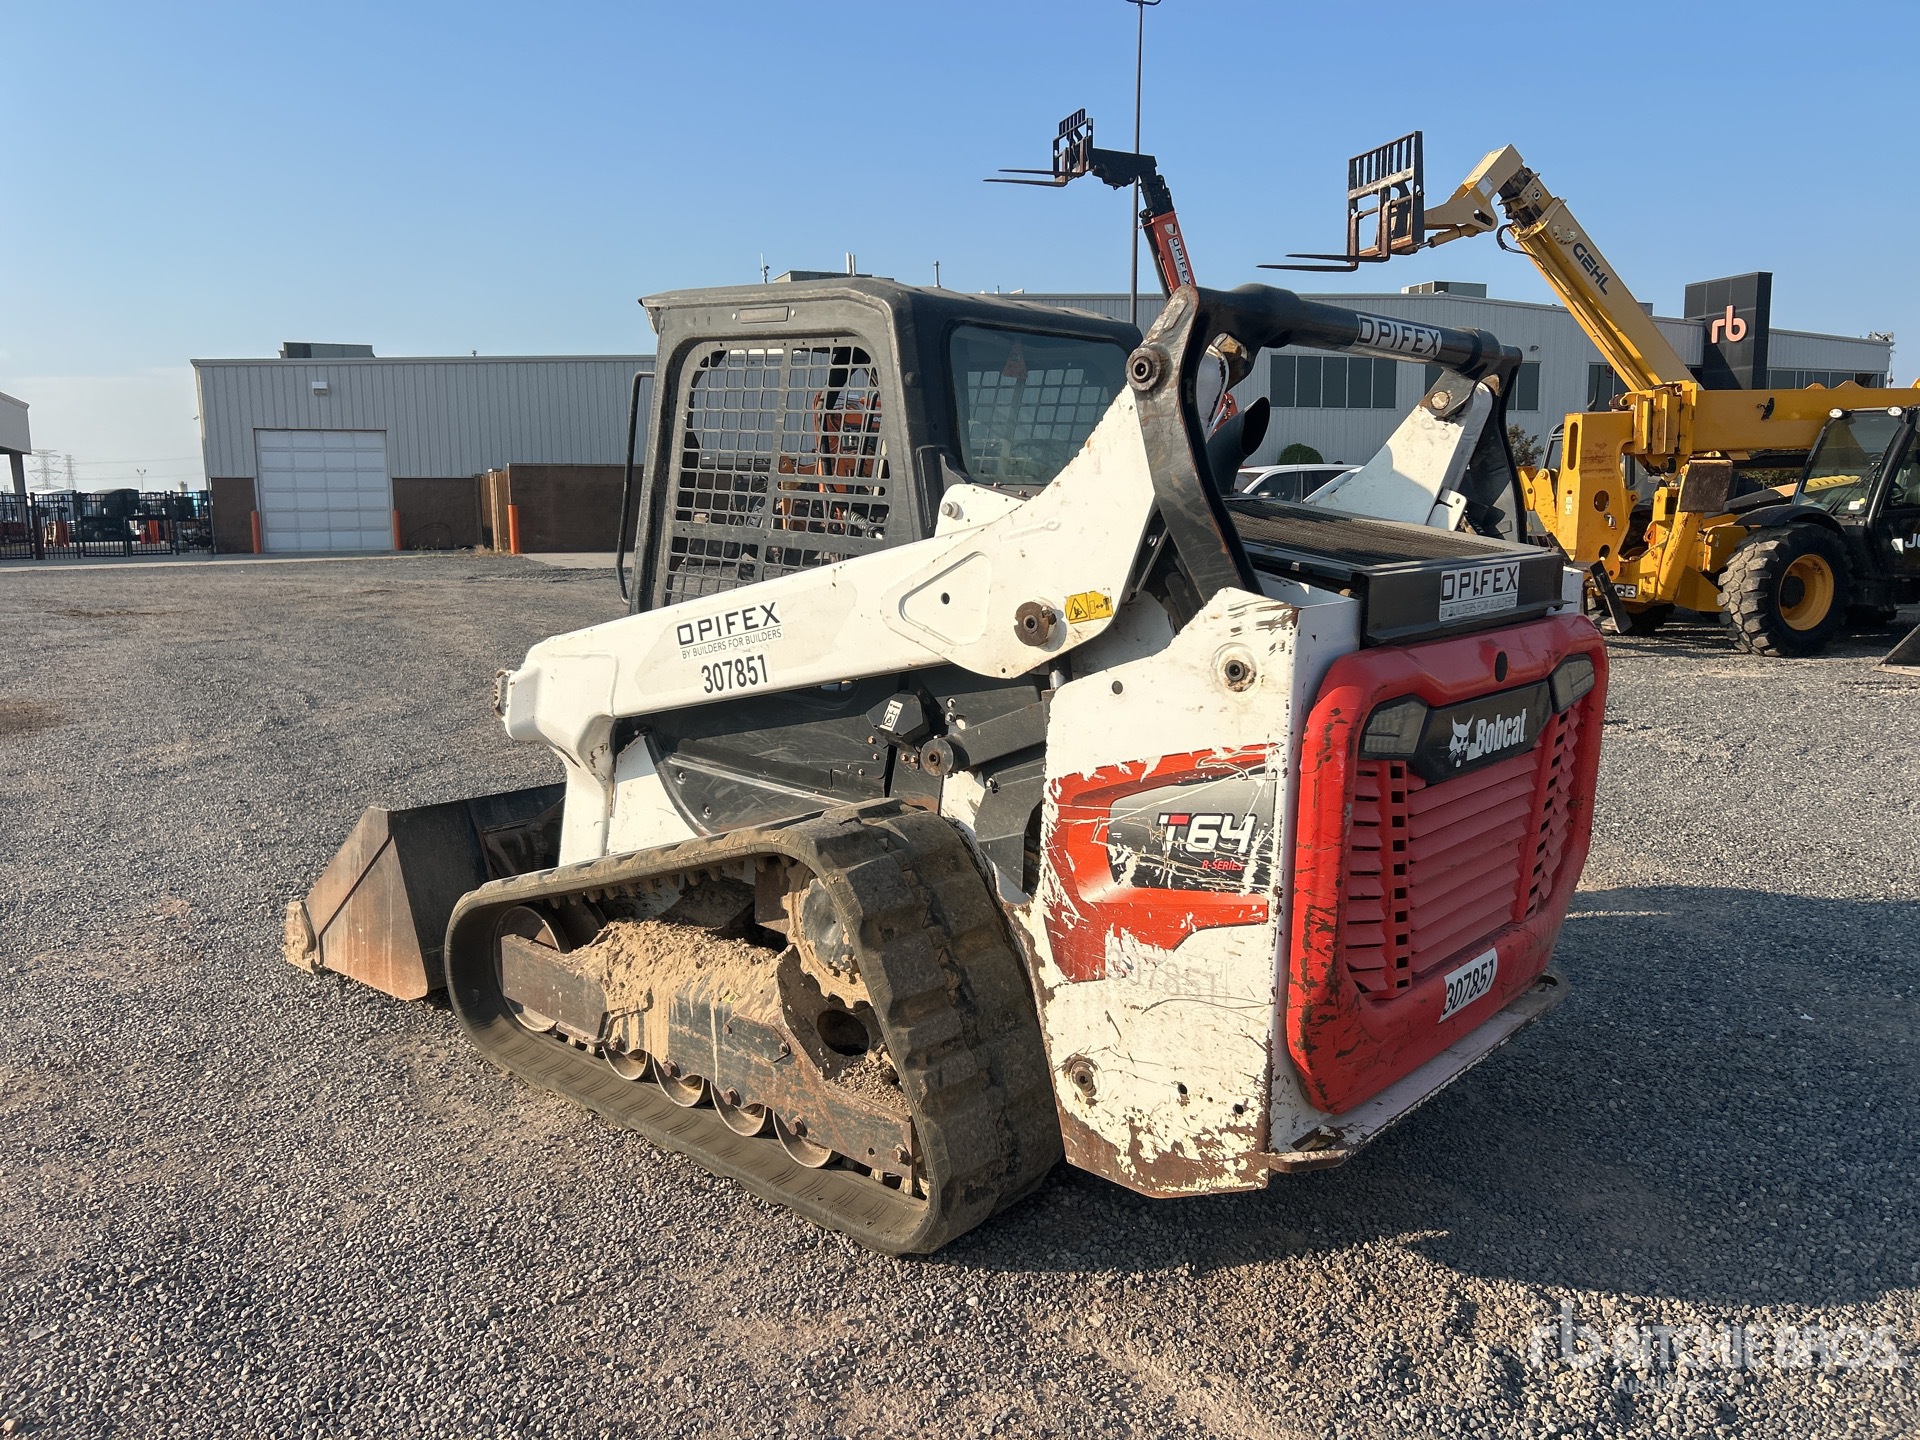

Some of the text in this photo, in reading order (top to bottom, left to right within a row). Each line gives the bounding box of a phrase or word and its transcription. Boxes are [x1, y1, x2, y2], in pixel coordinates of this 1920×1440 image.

[1573, 242, 1609, 296] GEHL
[1357, 317, 1439, 355] OPIFEX
[1711, 305, 1747, 344] rb
[1441, 566, 1518, 601] OPIFEX
[1614, 584, 1636, 598] CB
[677, 602, 780, 646] OPIFEX
[682, 628, 782, 659] BY BUILDERS FOR BUILDERS
[701, 654, 768, 693] 307851
[1475, 708, 1527, 754] Bobcat
[1156, 813, 1257, 853] T64
[1202, 859, 1244, 871] R-SERIES
[1442, 959, 1494, 1015] 307851
